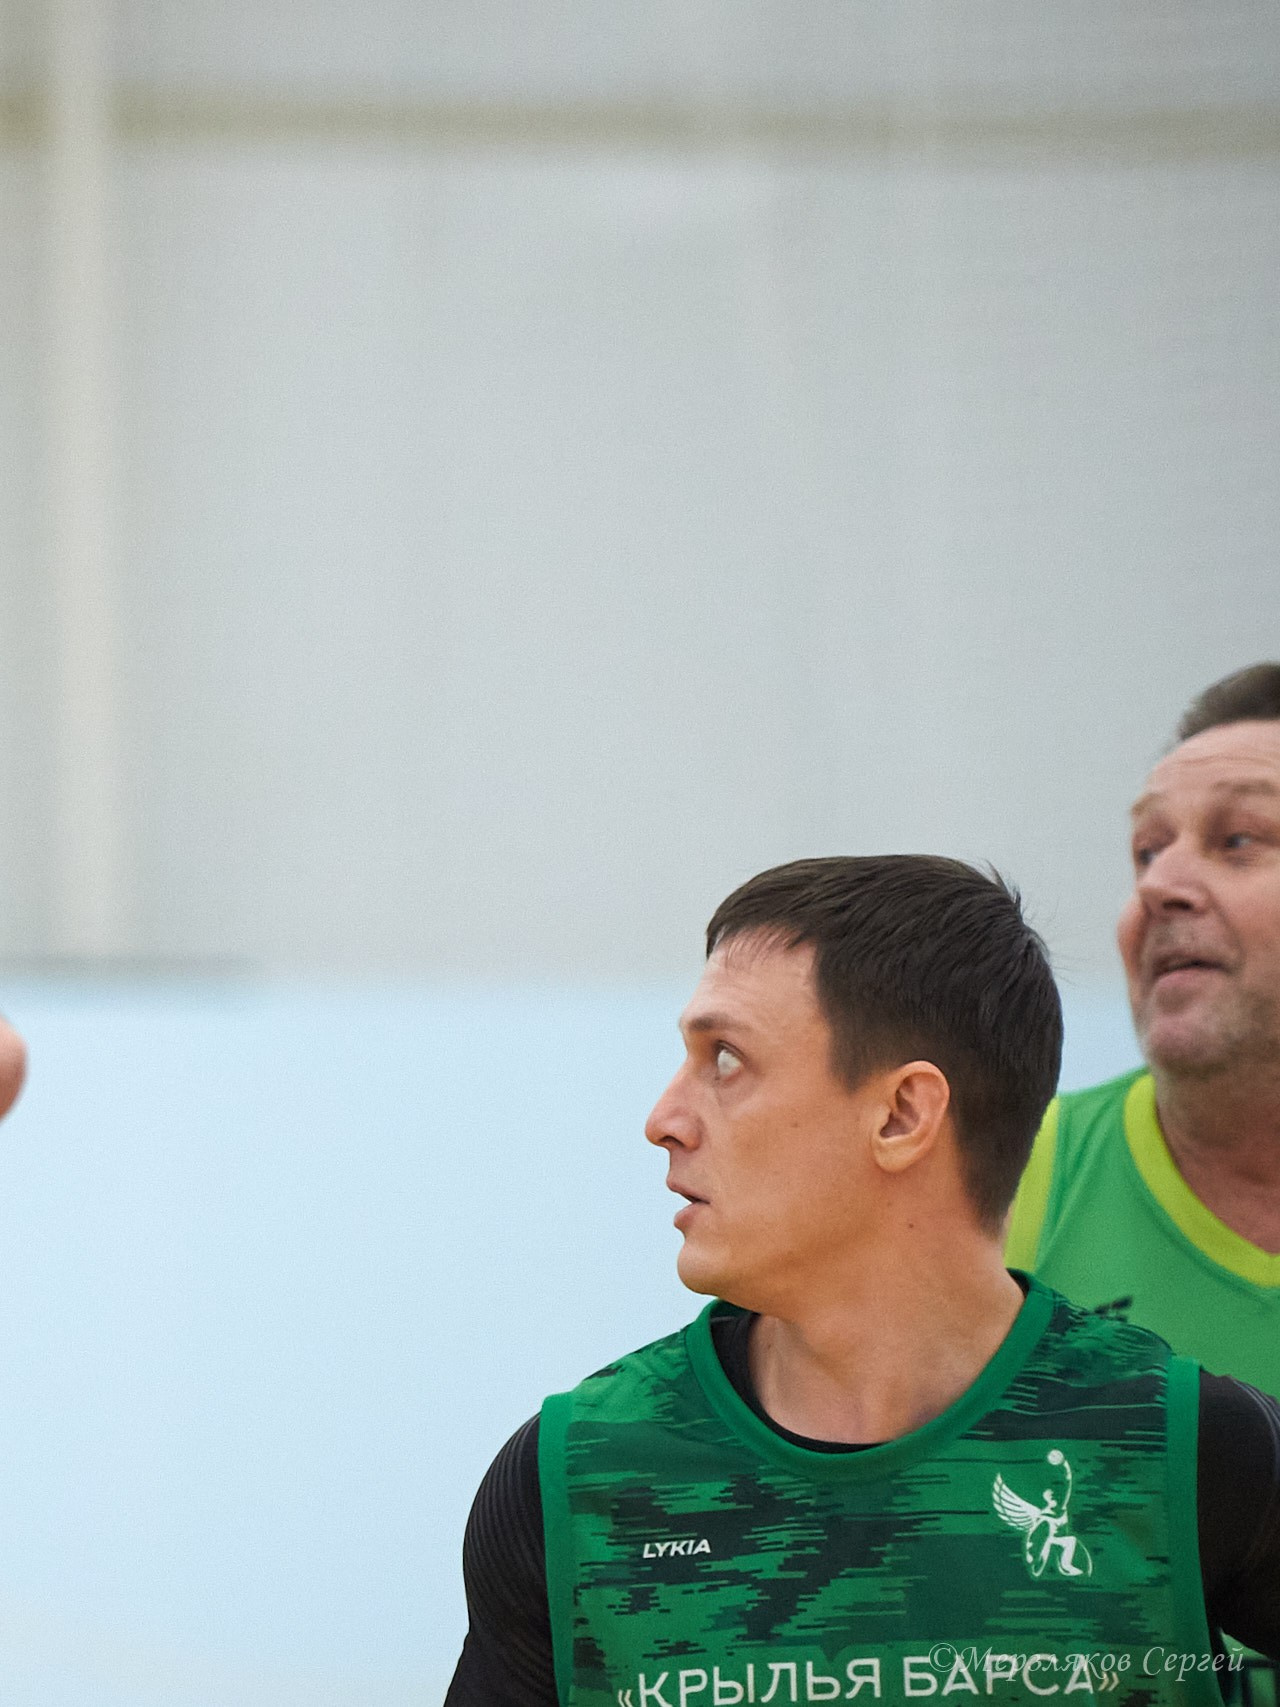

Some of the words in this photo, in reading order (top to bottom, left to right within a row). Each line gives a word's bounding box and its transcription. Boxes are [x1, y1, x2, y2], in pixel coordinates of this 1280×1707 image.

[643, 1539, 712, 1559] LYKIA
[618, 1657, 881, 1707] «КРЫЛЬЯ
[903, 1653, 1120, 1697] БАРСА»
